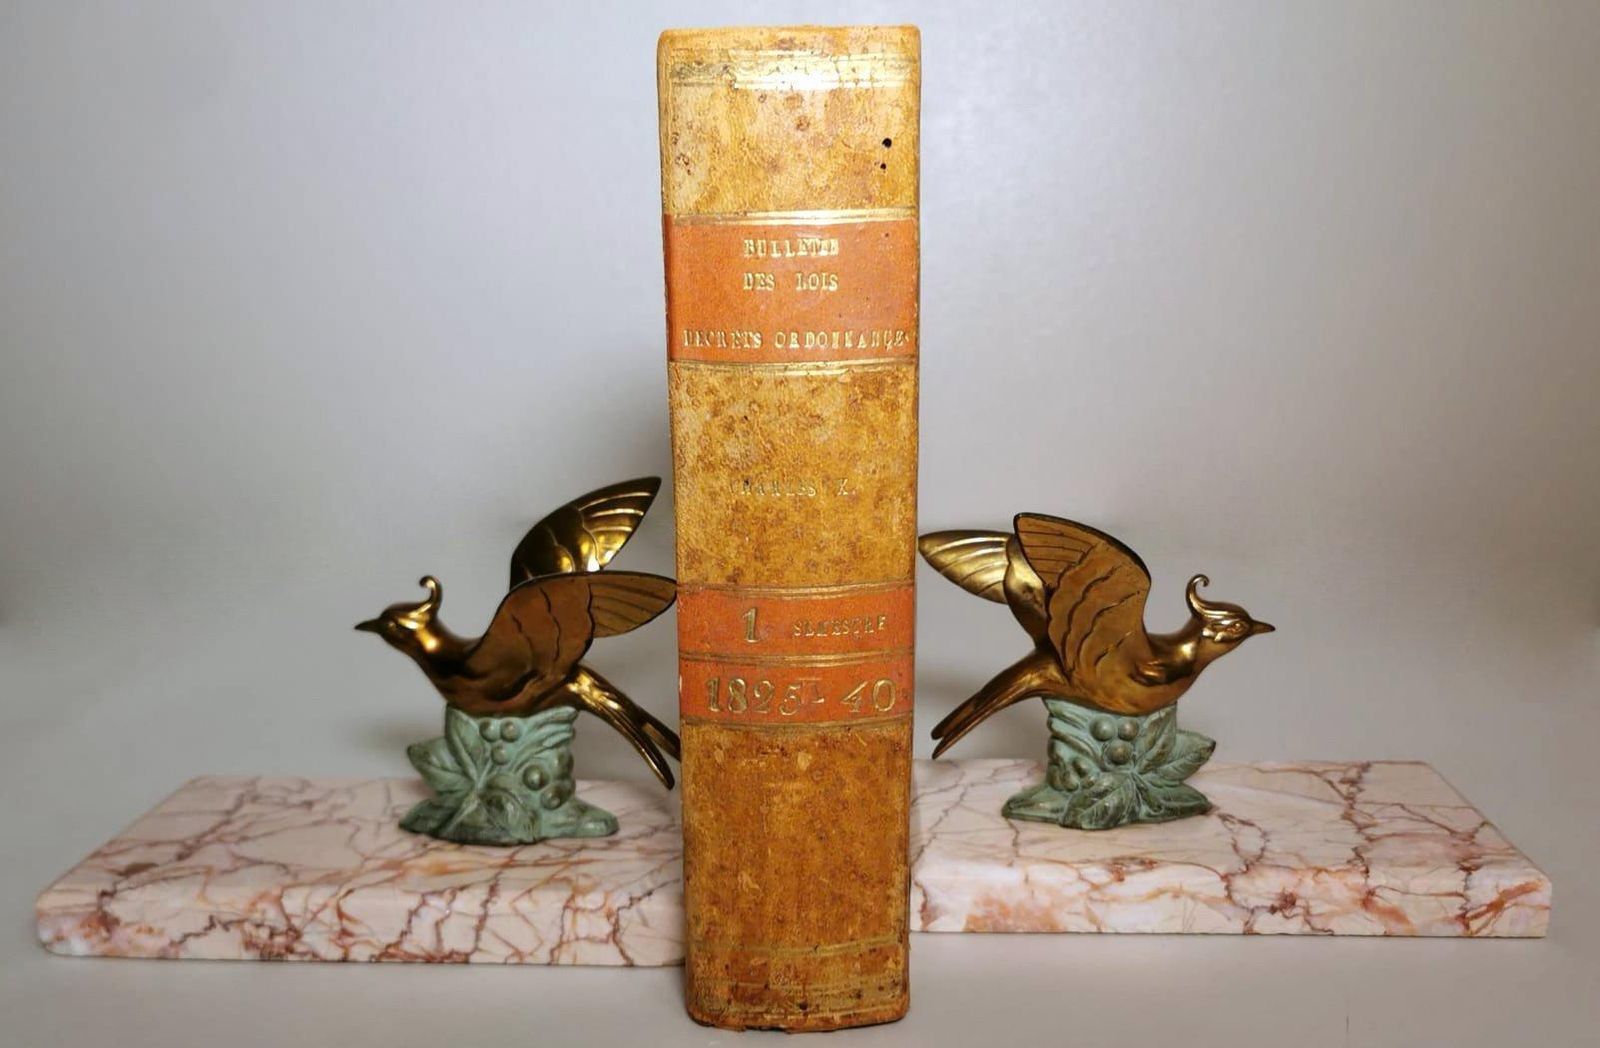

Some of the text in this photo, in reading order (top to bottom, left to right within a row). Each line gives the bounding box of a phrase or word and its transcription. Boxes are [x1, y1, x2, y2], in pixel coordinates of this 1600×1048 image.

[742, 272, 839, 291] DES LOIS
[774, 329, 910, 351] ORDONNANCE
[729, 478, 817, 497] HARLES
[841, 678, 897, 713] 40
